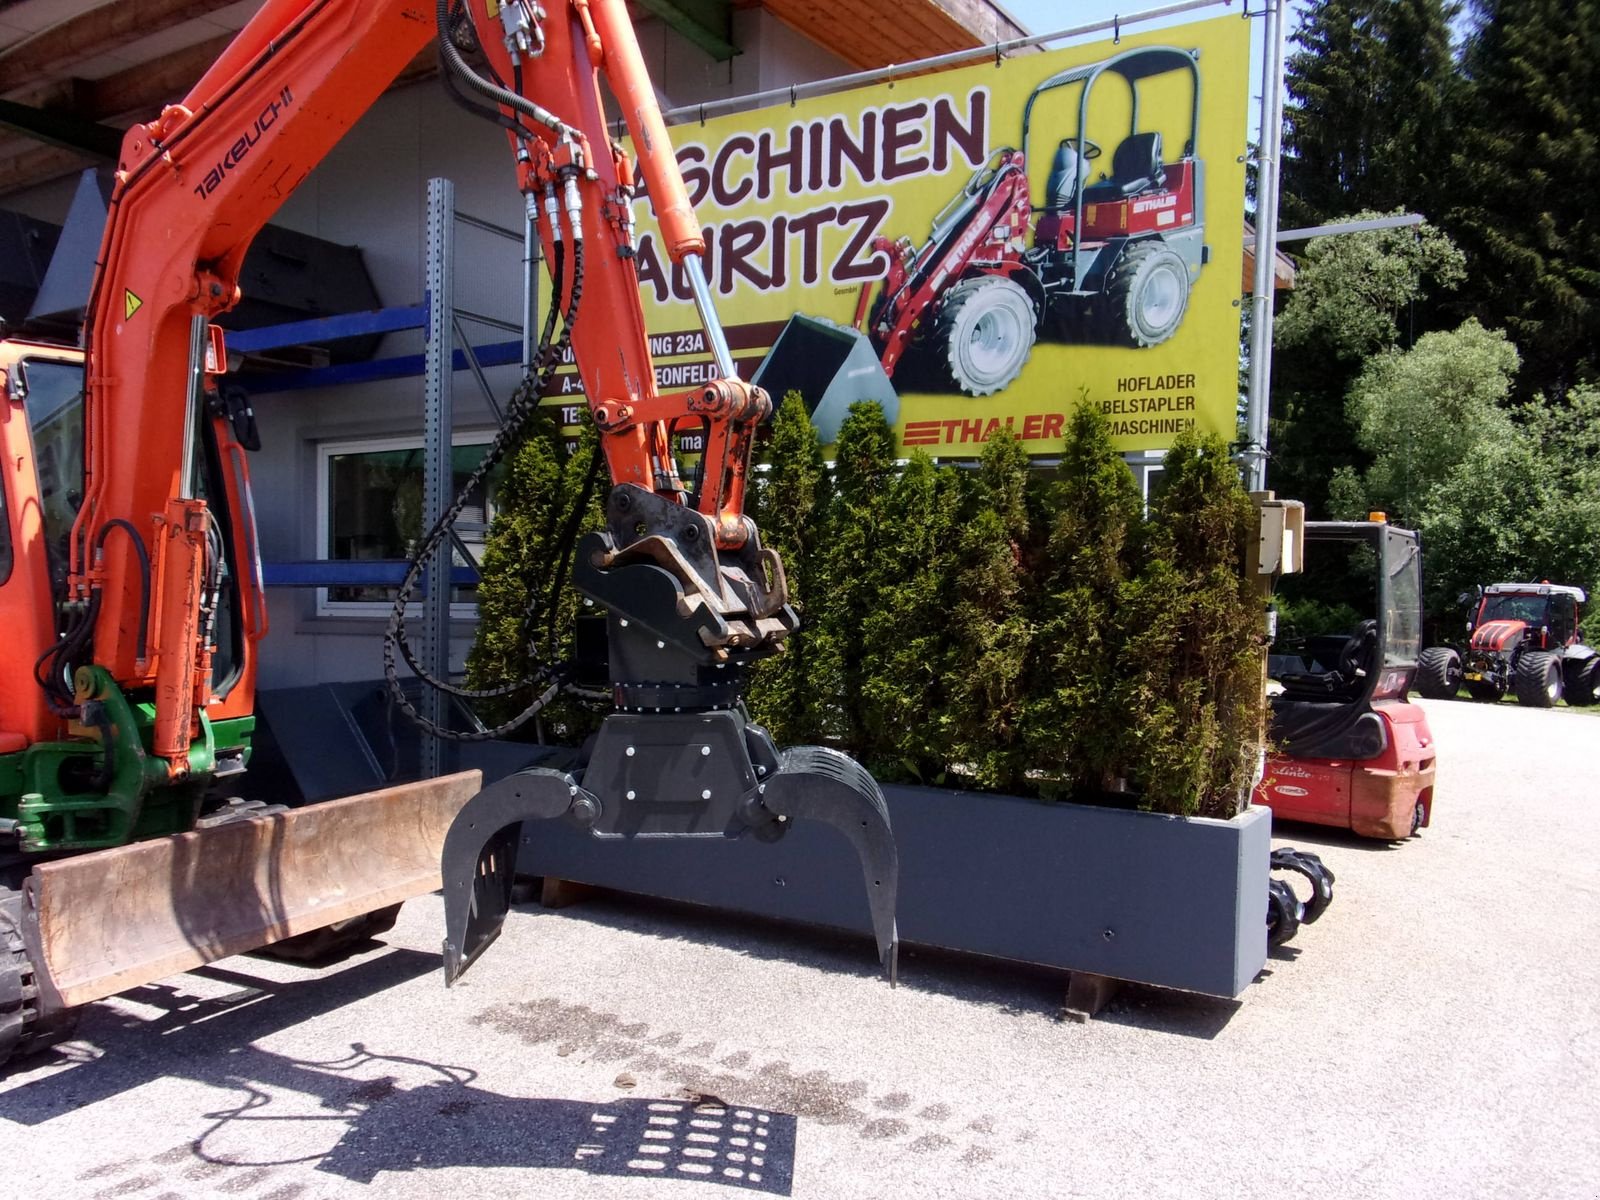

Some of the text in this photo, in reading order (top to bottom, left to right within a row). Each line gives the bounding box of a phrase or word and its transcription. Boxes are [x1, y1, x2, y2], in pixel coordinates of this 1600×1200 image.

[676, 333, 704, 354] 23A
[1117, 373, 1195, 393] HOFLADER
[941, 413, 1066, 445] THALER
